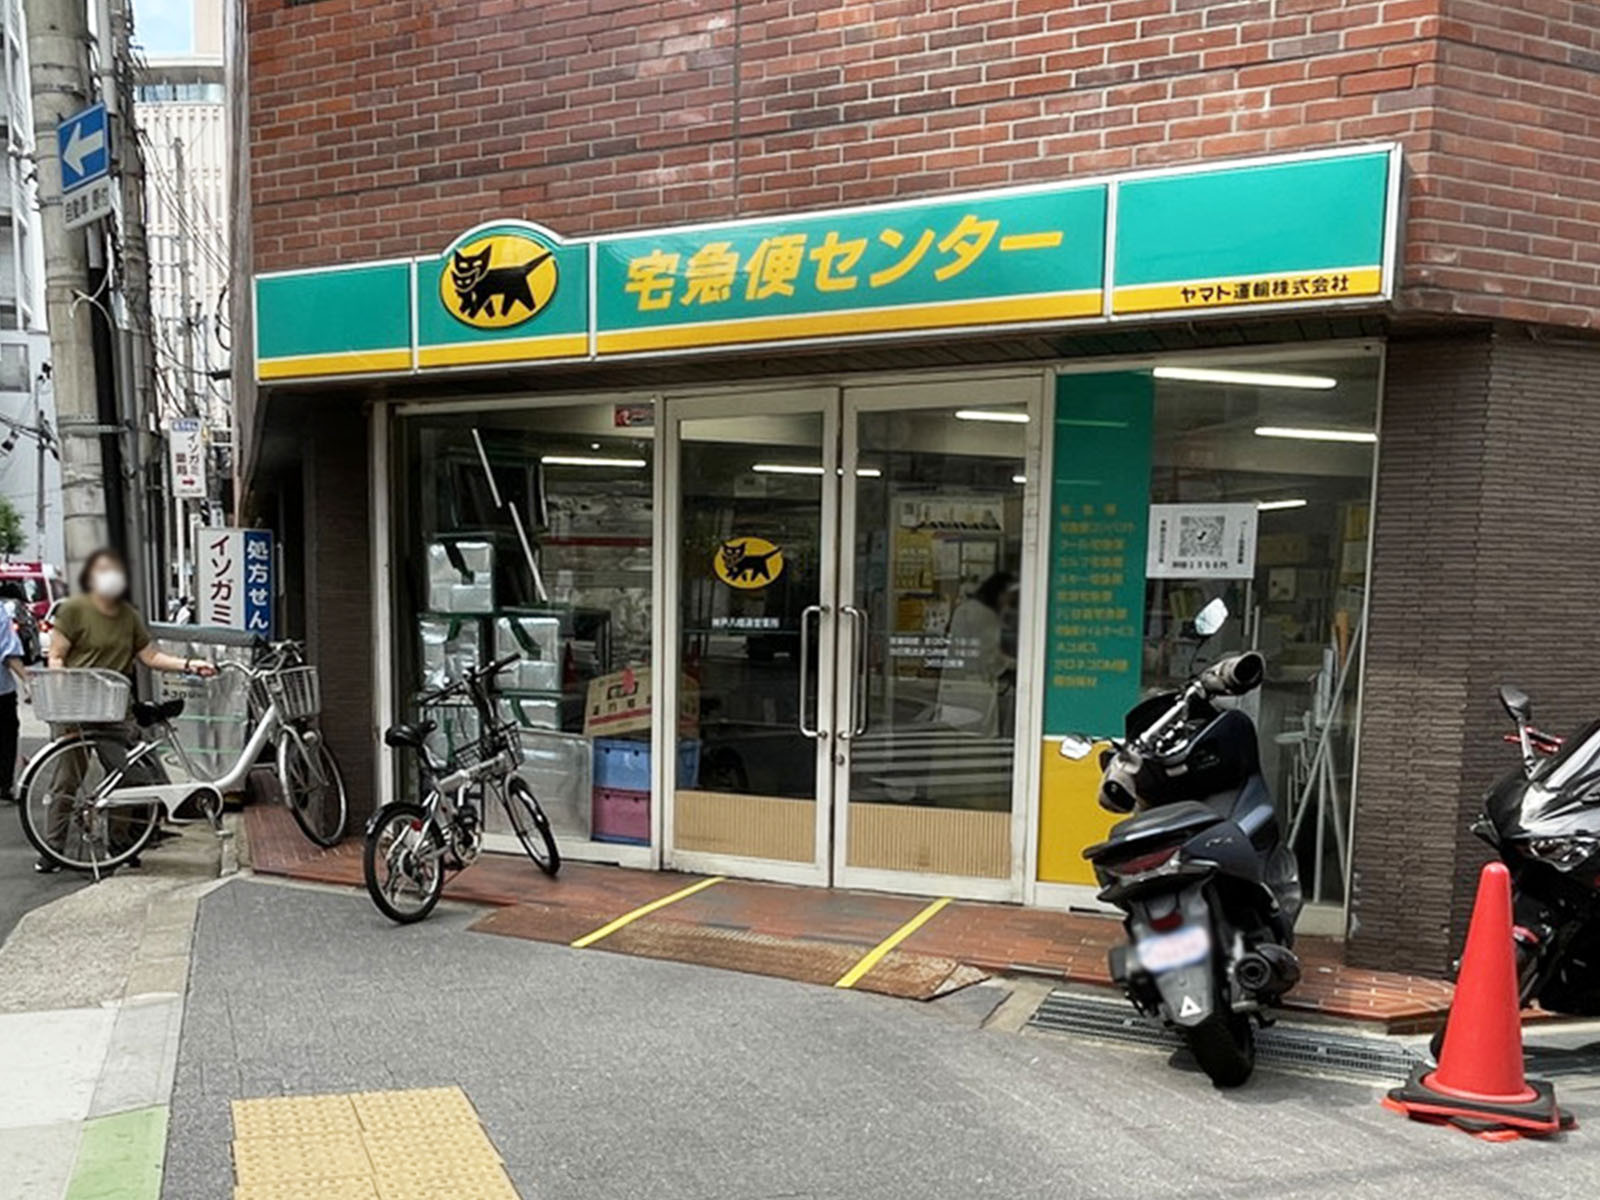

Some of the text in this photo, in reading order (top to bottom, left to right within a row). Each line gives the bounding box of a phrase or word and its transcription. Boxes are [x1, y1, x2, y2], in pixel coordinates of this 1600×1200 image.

[624, 214, 1064, 311] 宅急便センター
[1181, 275, 1348, 303] ヤマト運輸株式会社
[187, 433, 200, 476] イソガミ
[210, 535, 234, 625] イソガミ
[247, 540, 268, 629] 処方せん
